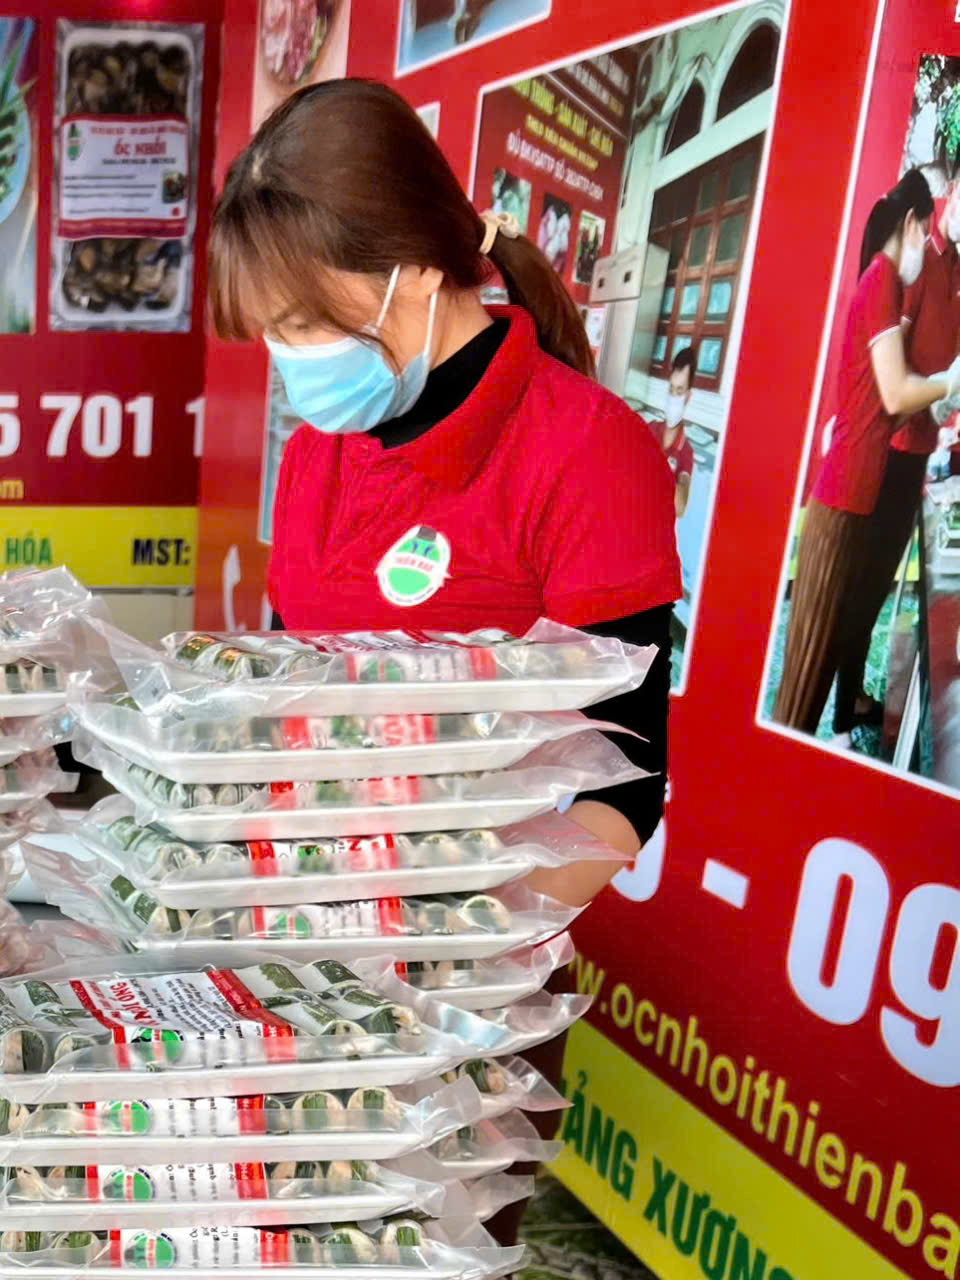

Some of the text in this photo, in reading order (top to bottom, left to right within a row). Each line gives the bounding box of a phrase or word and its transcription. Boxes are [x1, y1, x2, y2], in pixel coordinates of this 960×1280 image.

[40, 394, 155, 458] 701
[5, 533, 53, 566] HÓA
[131, 538, 192, 567] MST:
[786, 836, 960, 1088] 09
[561, 1070, 638, 1201] ẢNG
